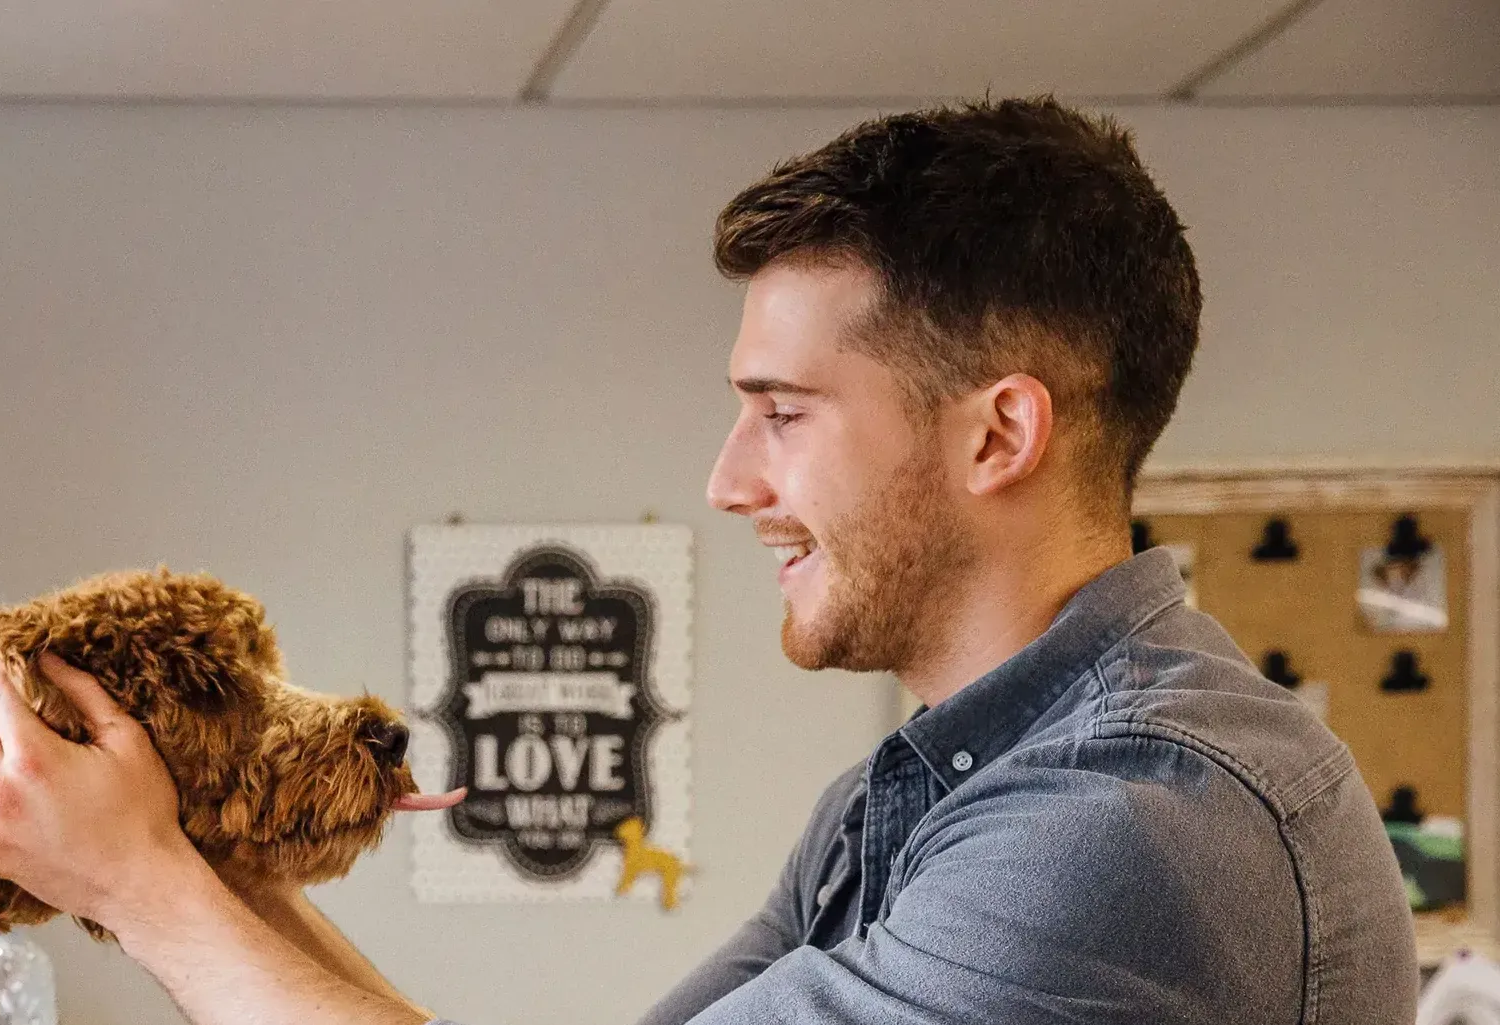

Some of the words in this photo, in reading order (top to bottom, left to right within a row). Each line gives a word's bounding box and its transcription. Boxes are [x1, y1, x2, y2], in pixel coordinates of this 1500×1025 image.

[520, 577, 585, 615] THE
[484, 616, 548, 644] ONLY
[557, 616, 618, 643] WAY
[474, 733, 626, 792] LOVE
